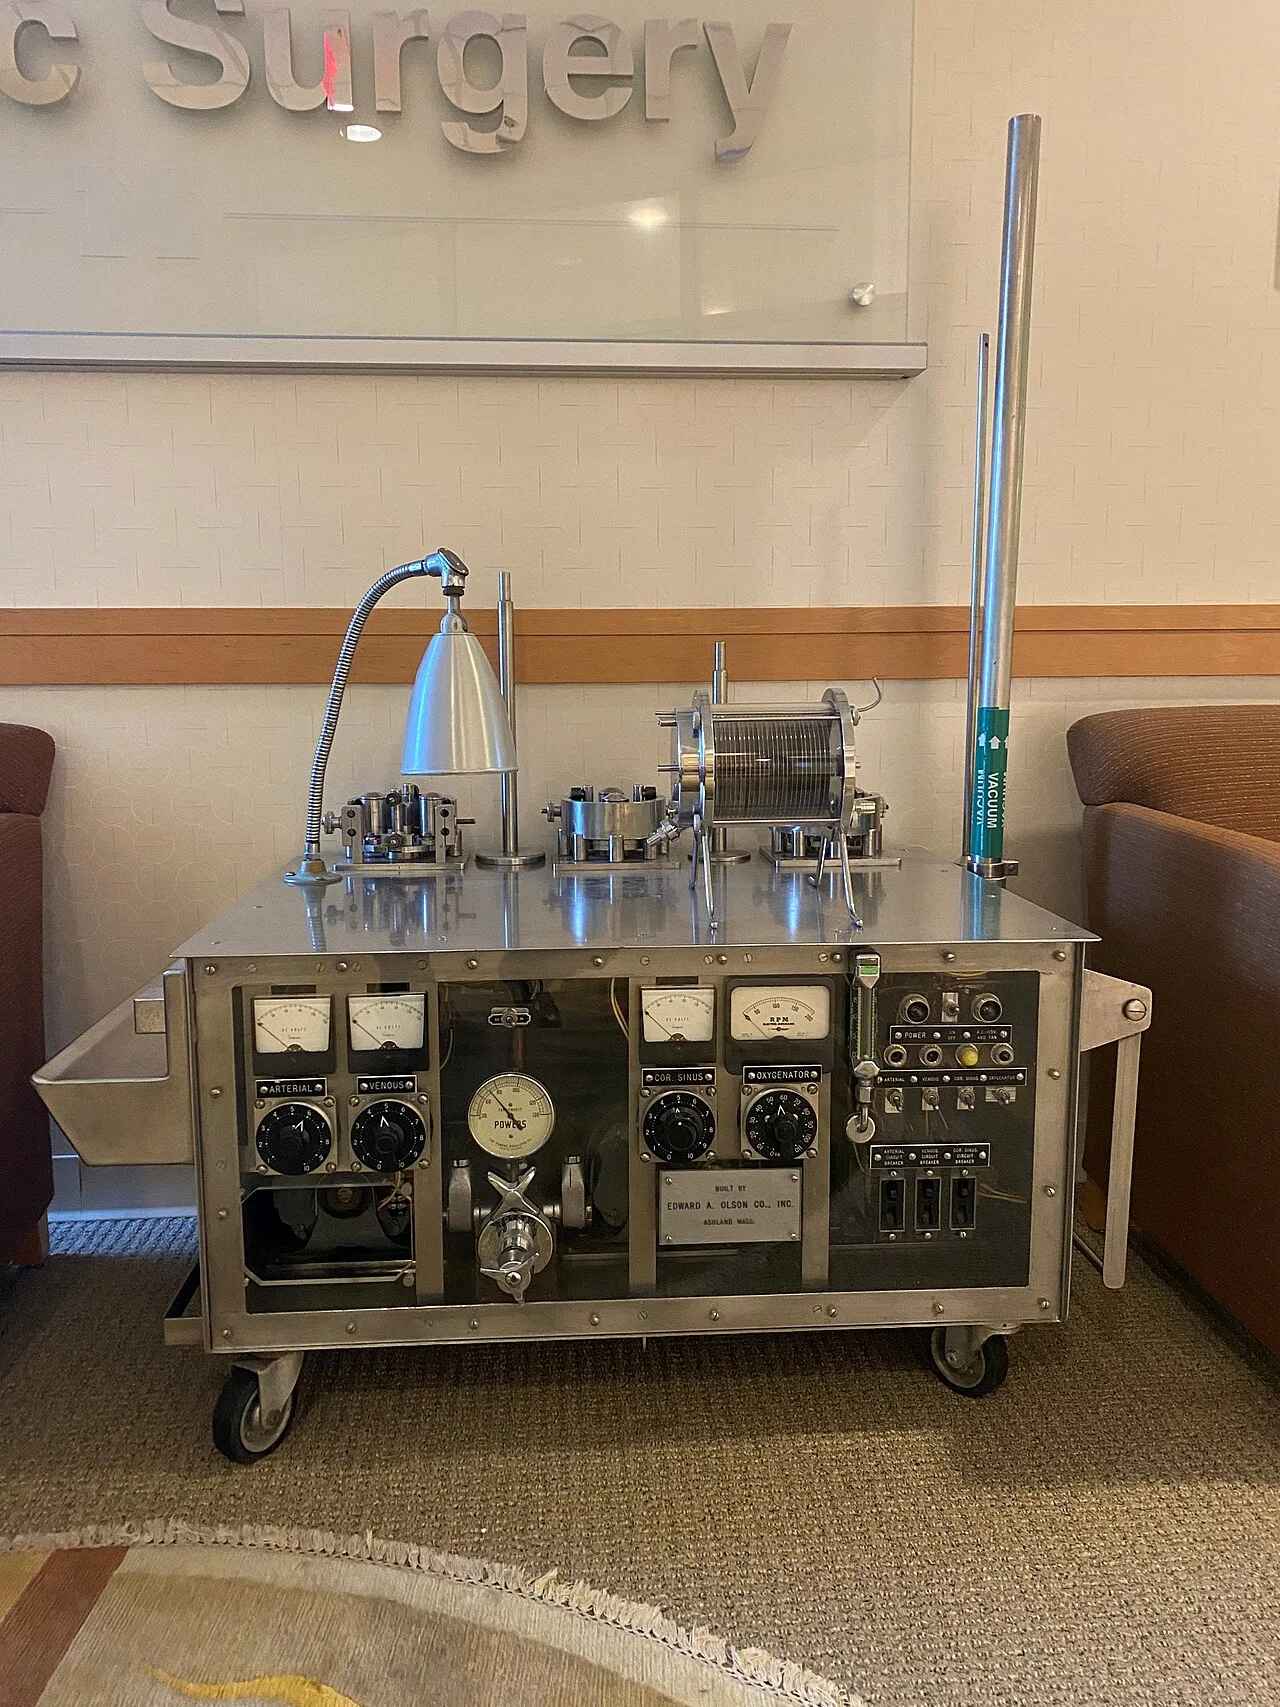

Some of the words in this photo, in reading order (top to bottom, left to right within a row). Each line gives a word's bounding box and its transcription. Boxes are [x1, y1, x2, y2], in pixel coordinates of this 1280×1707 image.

[141, 0, 792, 163] Surgery
[987, 772, 999, 828] VACUUM
[655, 1074, 674, 1082] COR.
[678, 1073, 703, 1081] SINUS
[757, 1071, 809, 1079] OXYGENATOR
[269, 1085, 312, 1093] ARTERIAL
[369, 1081, 404, 1089] VENOUS
[668, 1202, 701, 1210] EDWARD
[721, 1201, 748, 1209] OLSON
[777, 1200, 793, 1208] INC.
